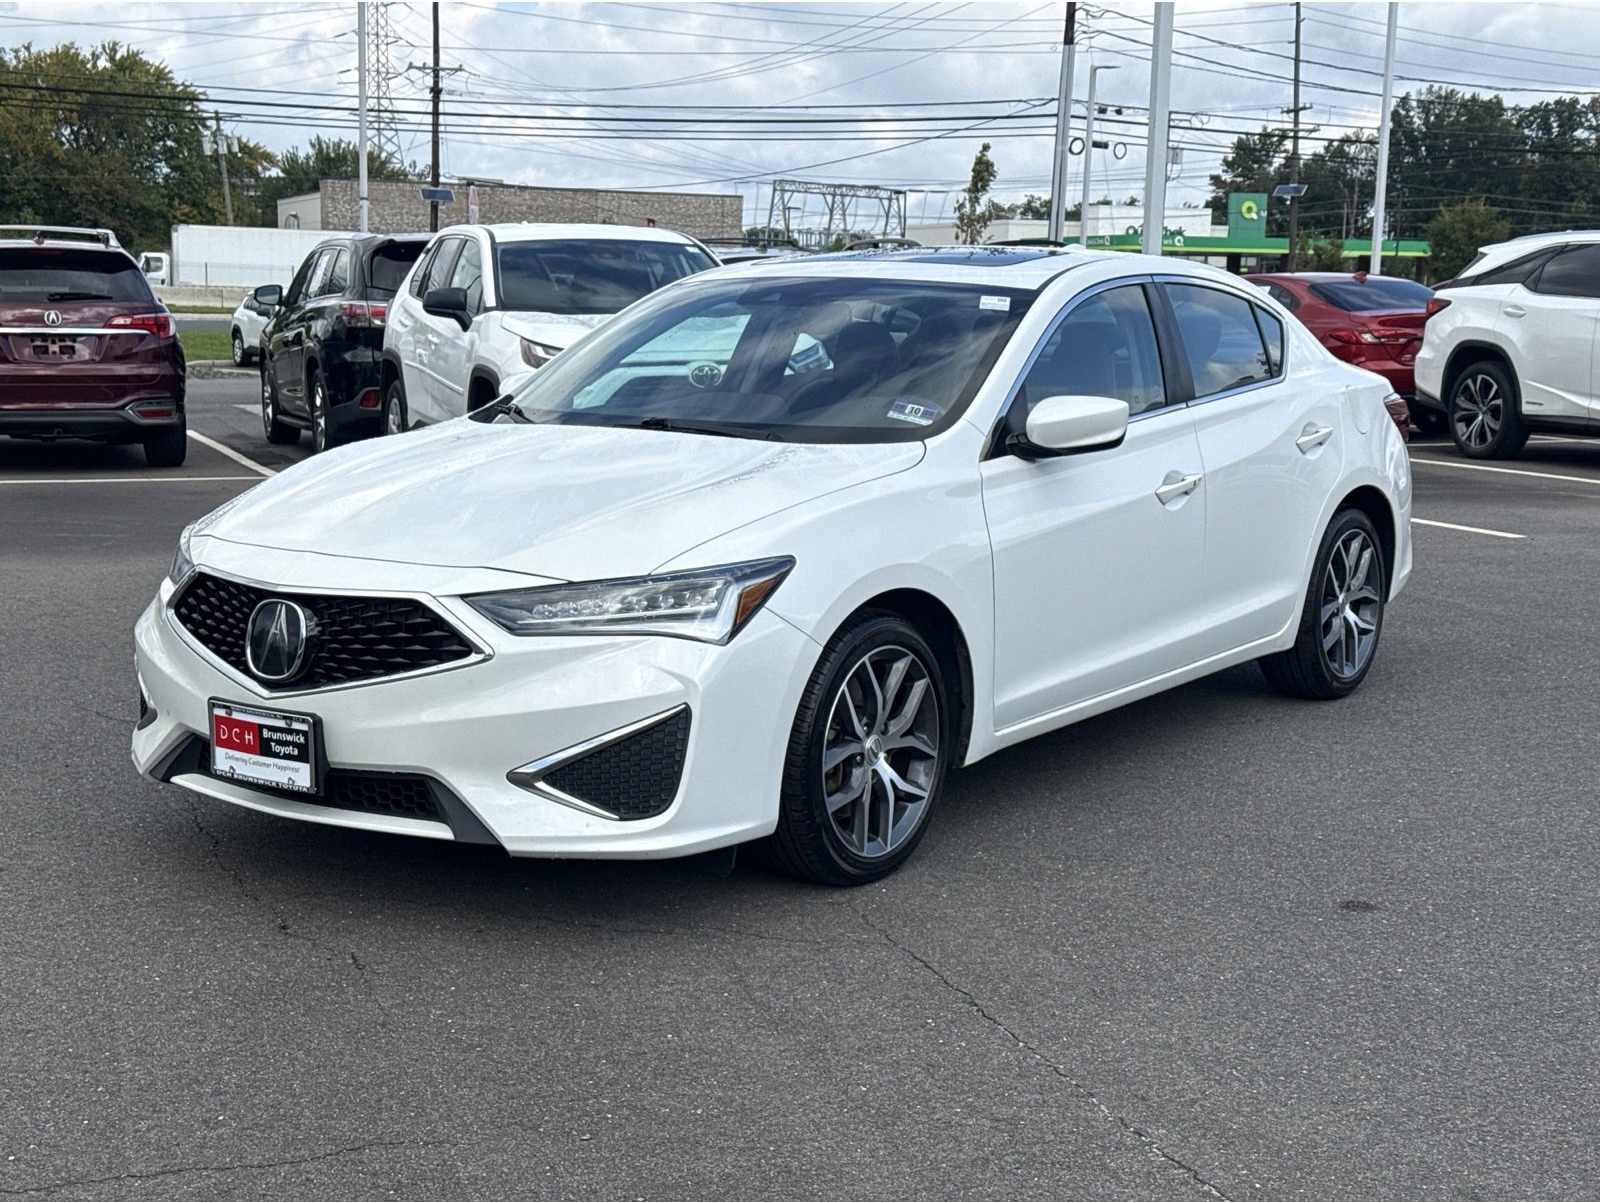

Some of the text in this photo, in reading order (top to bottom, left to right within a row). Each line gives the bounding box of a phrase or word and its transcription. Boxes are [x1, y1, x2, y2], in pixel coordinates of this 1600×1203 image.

[909, 406, 921, 415] 10
[262, 728, 305, 744] Brunswick
[270, 742, 298, 757] Toyota
[216, 769, 308, 792] DCH BRUNSWICK TOYOTA
